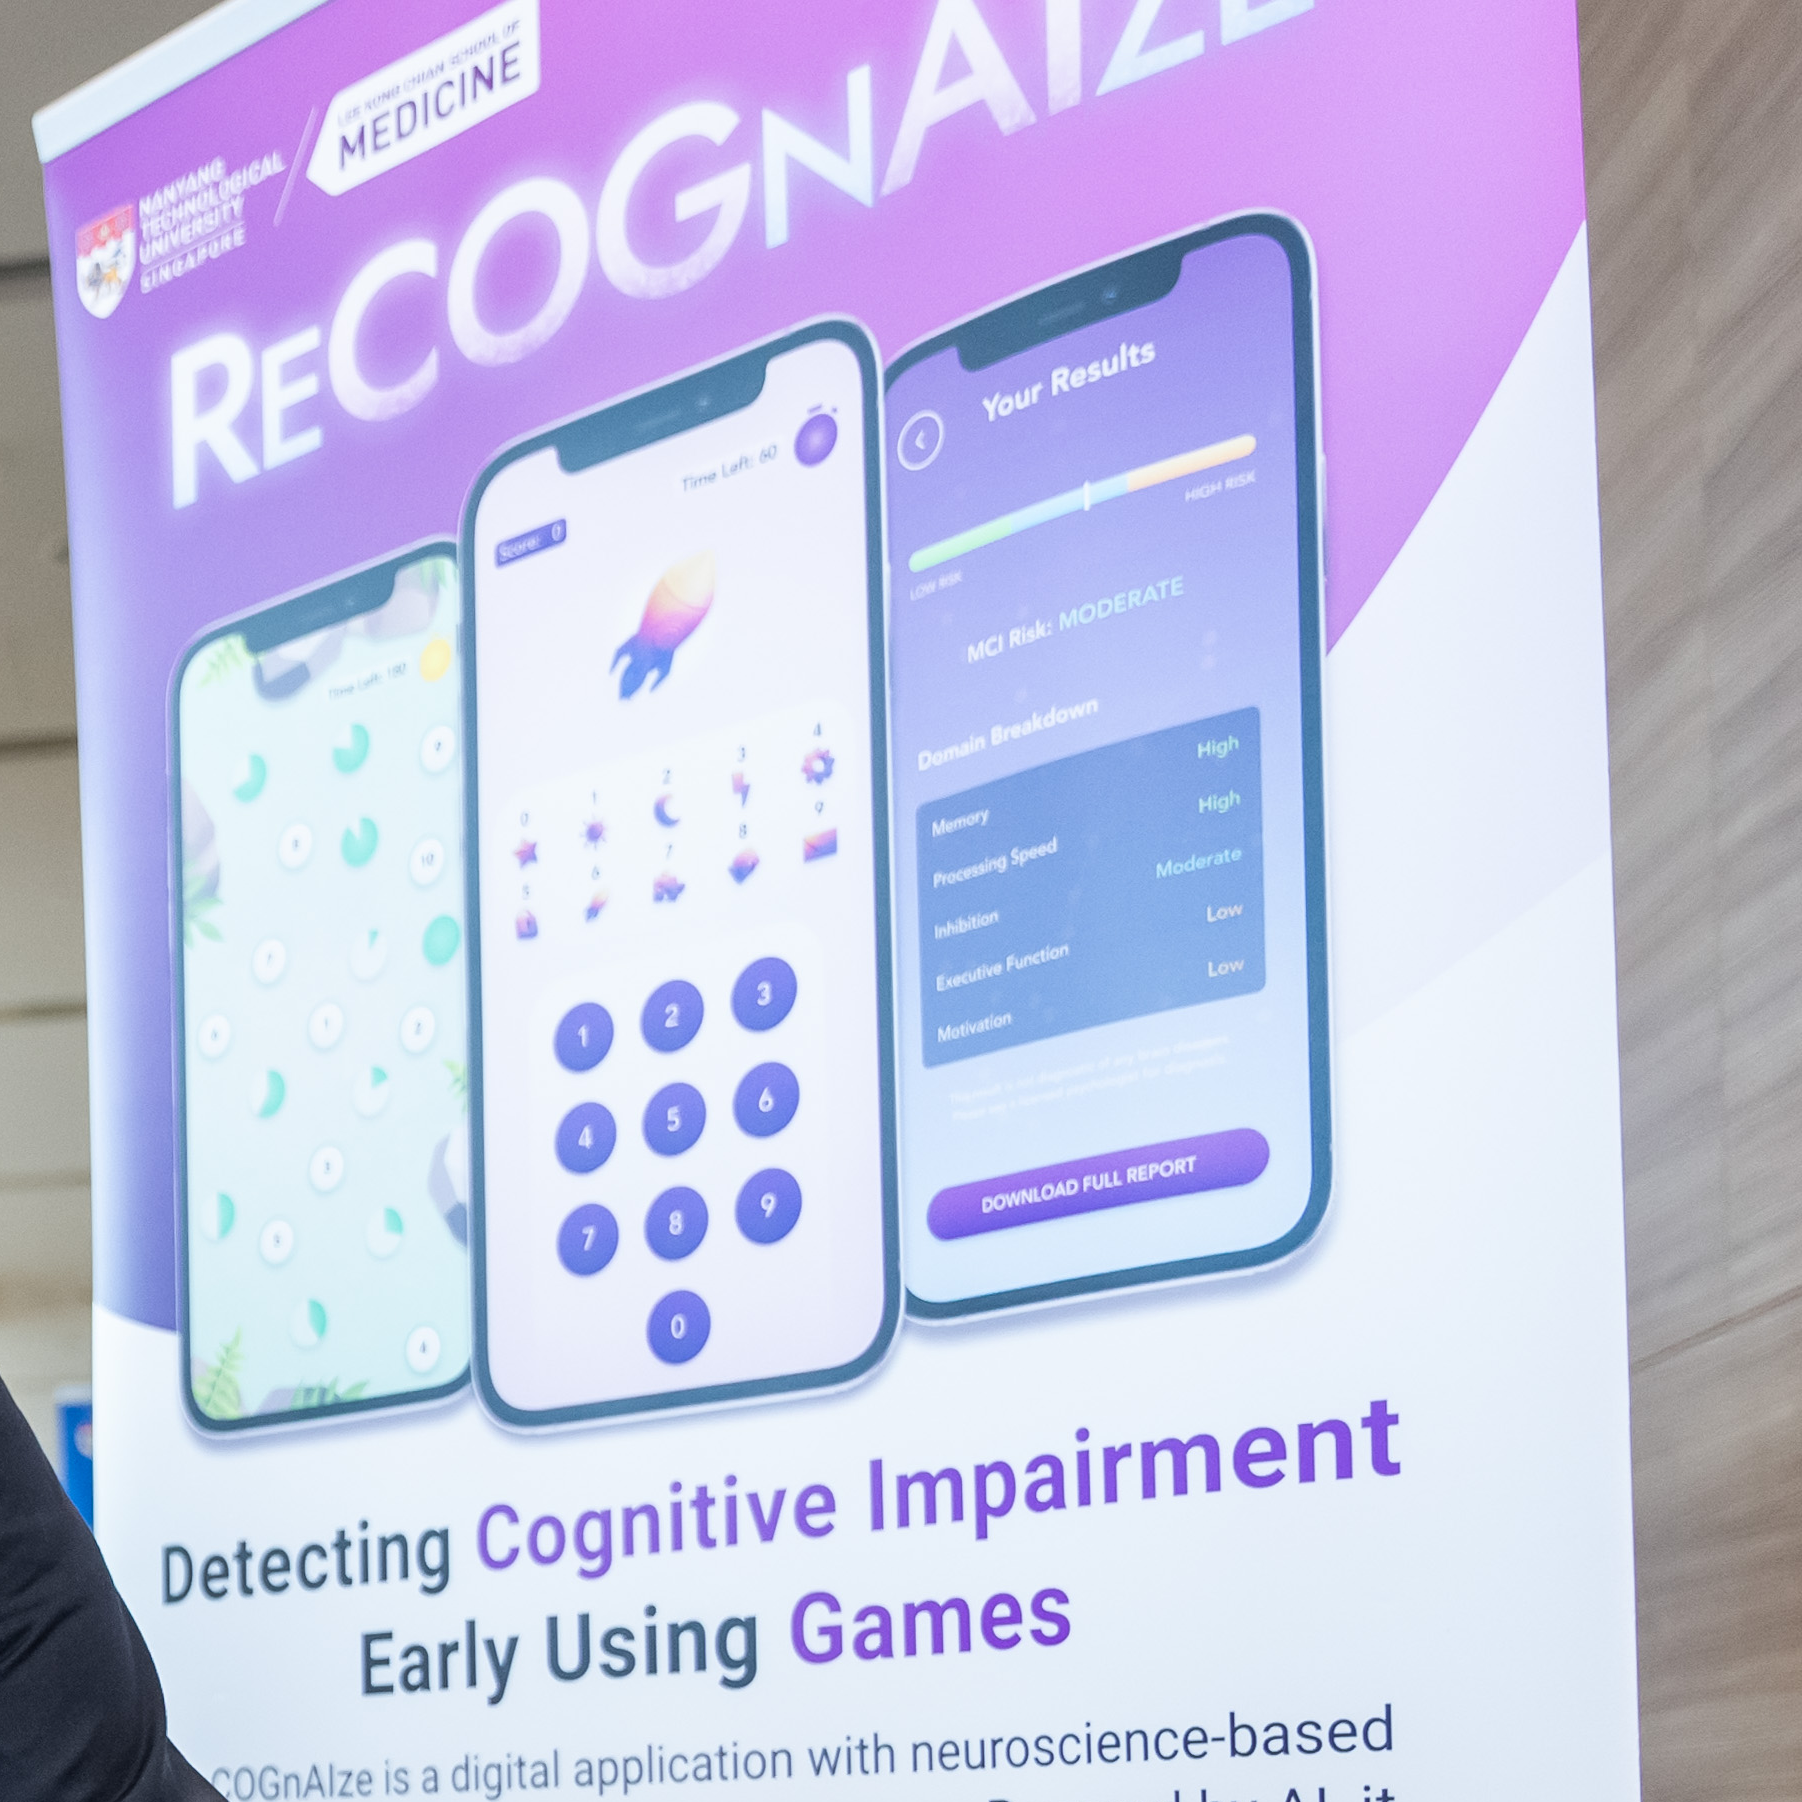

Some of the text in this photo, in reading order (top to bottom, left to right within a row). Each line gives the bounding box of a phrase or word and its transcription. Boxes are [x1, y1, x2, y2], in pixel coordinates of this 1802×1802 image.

[339, 40, 522, 170] MEDICINE
[139, 155, 226, 218] NANYANG
[142, 151, 287, 240] TECHNOLOGICAL
[139, 195, 245, 265] UNIVERSITY
[140, 226, 247, 294] SINGAPORE
[982, 341, 1157, 422] Your Results
[682, 443, 778, 492] Time Left: 60
[1184, 469, 1257, 502] HIGH RISK
[966, 575, 1185, 664] MCI Risk: MODERATE
[917, 698, 1099, 771] Domain Breakdown
[1197, 735, 1240, 759] High
[1198, 790, 1242, 814] High
[932, 807, 990, 837] Memory
[933, 837, 1058, 888] Processing Speed
[1156, 847, 1243, 879] Moderate
[934, 909, 999, 940] Inhibition
[1206, 902, 1244, 924] Low
[936, 943, 1070, 992] Executive Function
[1207, 957, 1245, 979] Low
[756, 982, 772, 1006] 3
[665, 1003, 679, 1029] 2
[937, 1012, 1012, 1044] Motivation
[578, 1025, 587, 1048] 1
[758, 1087, 774, 1113] 6
[667, 1106, 681, 1132] 5
[578, 1125, 594, 1149] 4
[982, 1155, 1197, 1214] DOWNLOAD FULL REPORT
[761, 1192, 776, 1218] 9
[581, 1226, 594, 1252] 7
[669, 1210, 684, 1236] 8
[670, 1313, 685, 1339] 0
[161, 1399, 1402, 1605] Detecting Cognitive Impairment
[360, 1587, 1072, 1706] Early Using Games
[211, 1703, 1395, 1801] COGnAIze is a digital application with neuroscience-based
